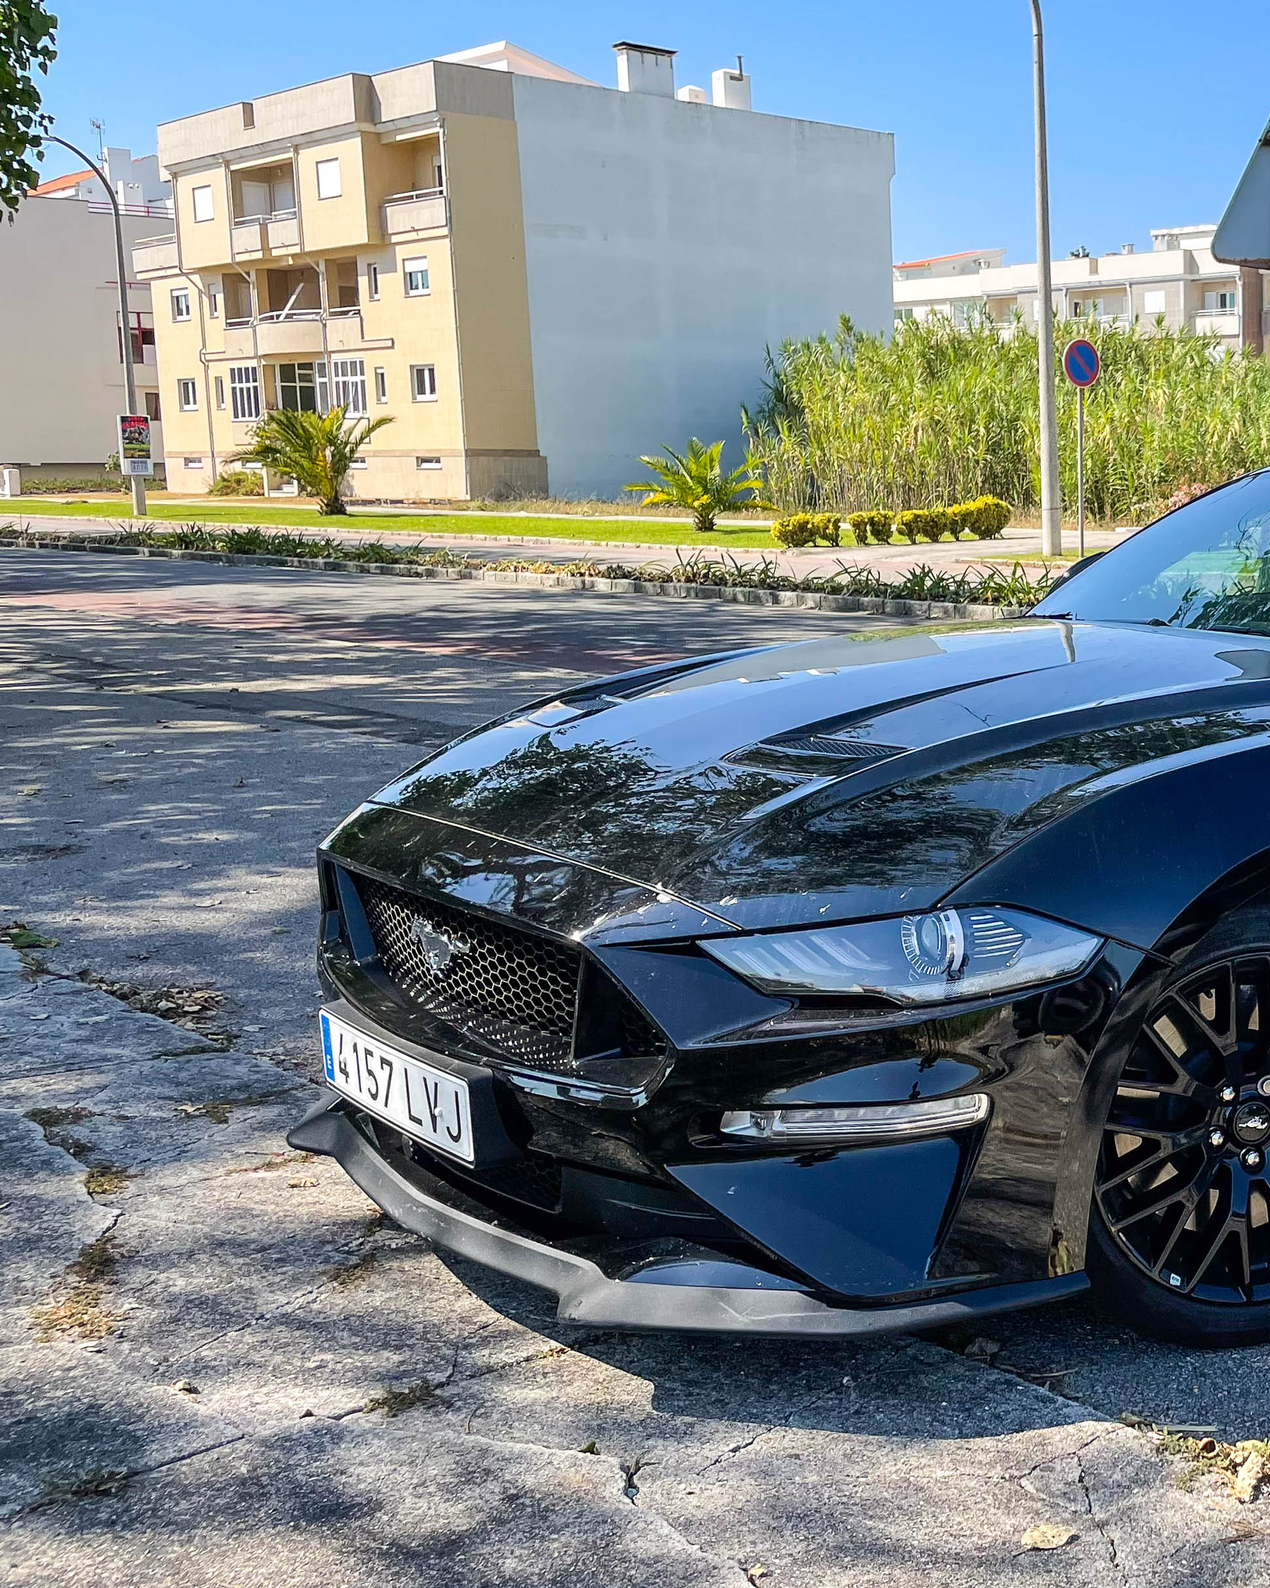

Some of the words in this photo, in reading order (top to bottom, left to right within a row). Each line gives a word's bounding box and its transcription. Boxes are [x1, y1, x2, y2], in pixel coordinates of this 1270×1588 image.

[326, 1054, 333, 1070] E
[338, 1033, 394, 1108] 4157
[404, 1067, 462, 1143] LVJ
